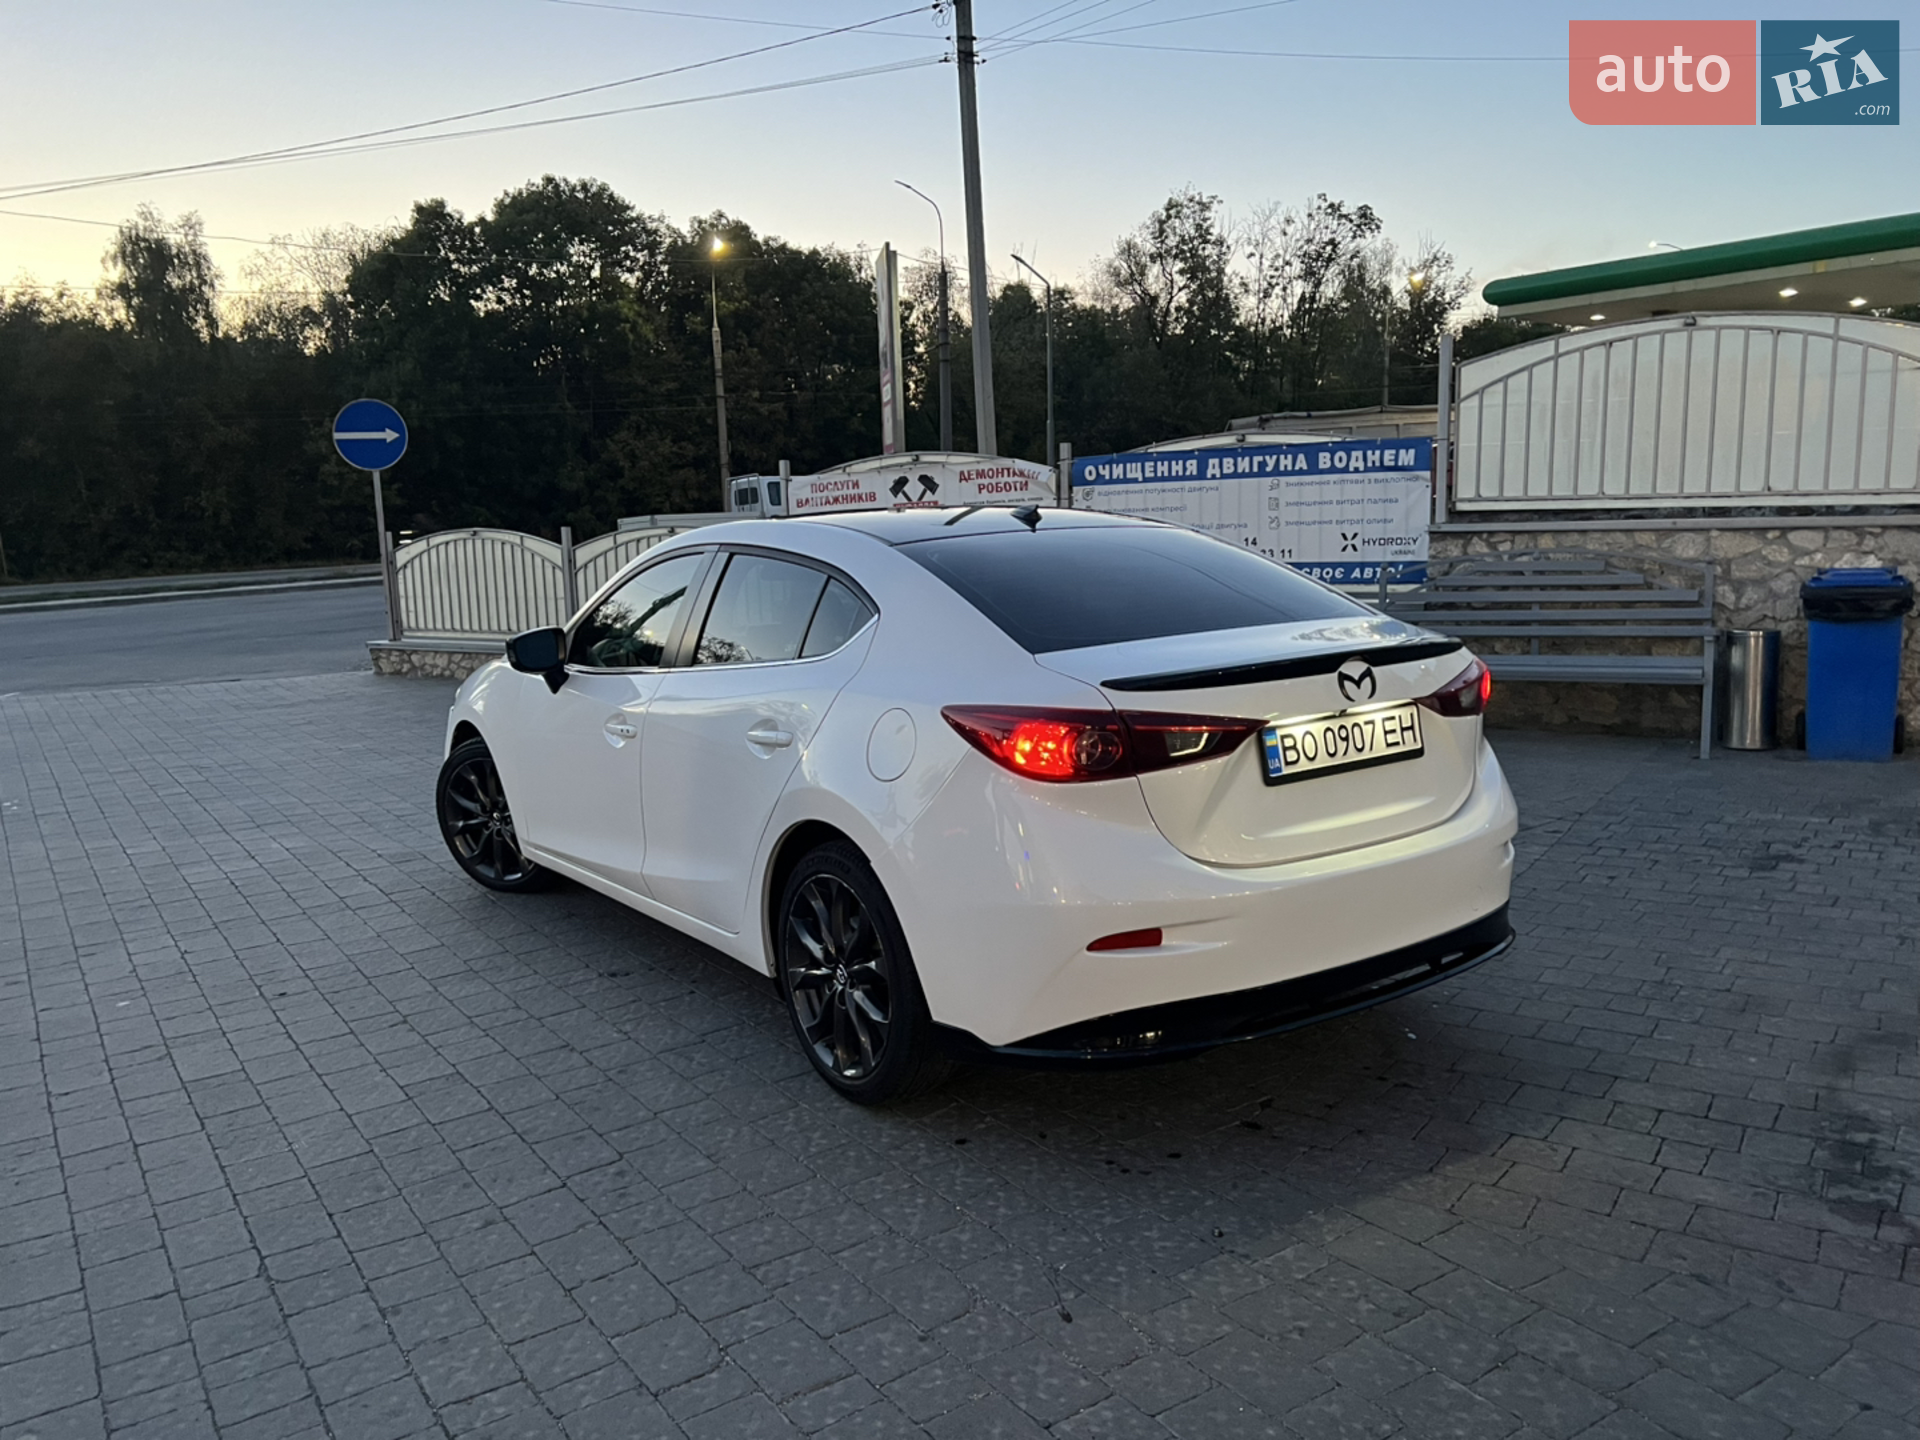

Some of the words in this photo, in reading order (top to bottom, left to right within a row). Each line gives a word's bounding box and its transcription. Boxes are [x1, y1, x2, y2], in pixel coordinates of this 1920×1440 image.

[1084, 459, 1198, 482] ОЧИЩЕННЯ
[1206, 453, 1308, 478] ДВИГУНА
[1318, 448, 1416, 472] ВОДНЕМ
[809, 479, 858, 494] ПОСЛУГИ
[978, 480, 1029, 494] РОБОТИ
[795, 491, 876, 508] ВАНТАЖНИКІВ
[1284, 499, 1334, 508] зменшення
[1335, 498, 1365, 507] витрат
[1366, 497, 1399, 506] палива
[1284, 519, 1333, 528] зменшення
[1335, 518, 1365, 527] витрат
[1244, 536, 1257, 547] 14
[1362, 537, 1419, 547] HYDROXY
[1280, 548, 1292, 559] 11
[1280, 730, 1317, 766] BO
[1323, 720, 1376, 758] 0907
[1382, 712, 1417, 748] EH
[1268, 758, 1281, 769] UA
